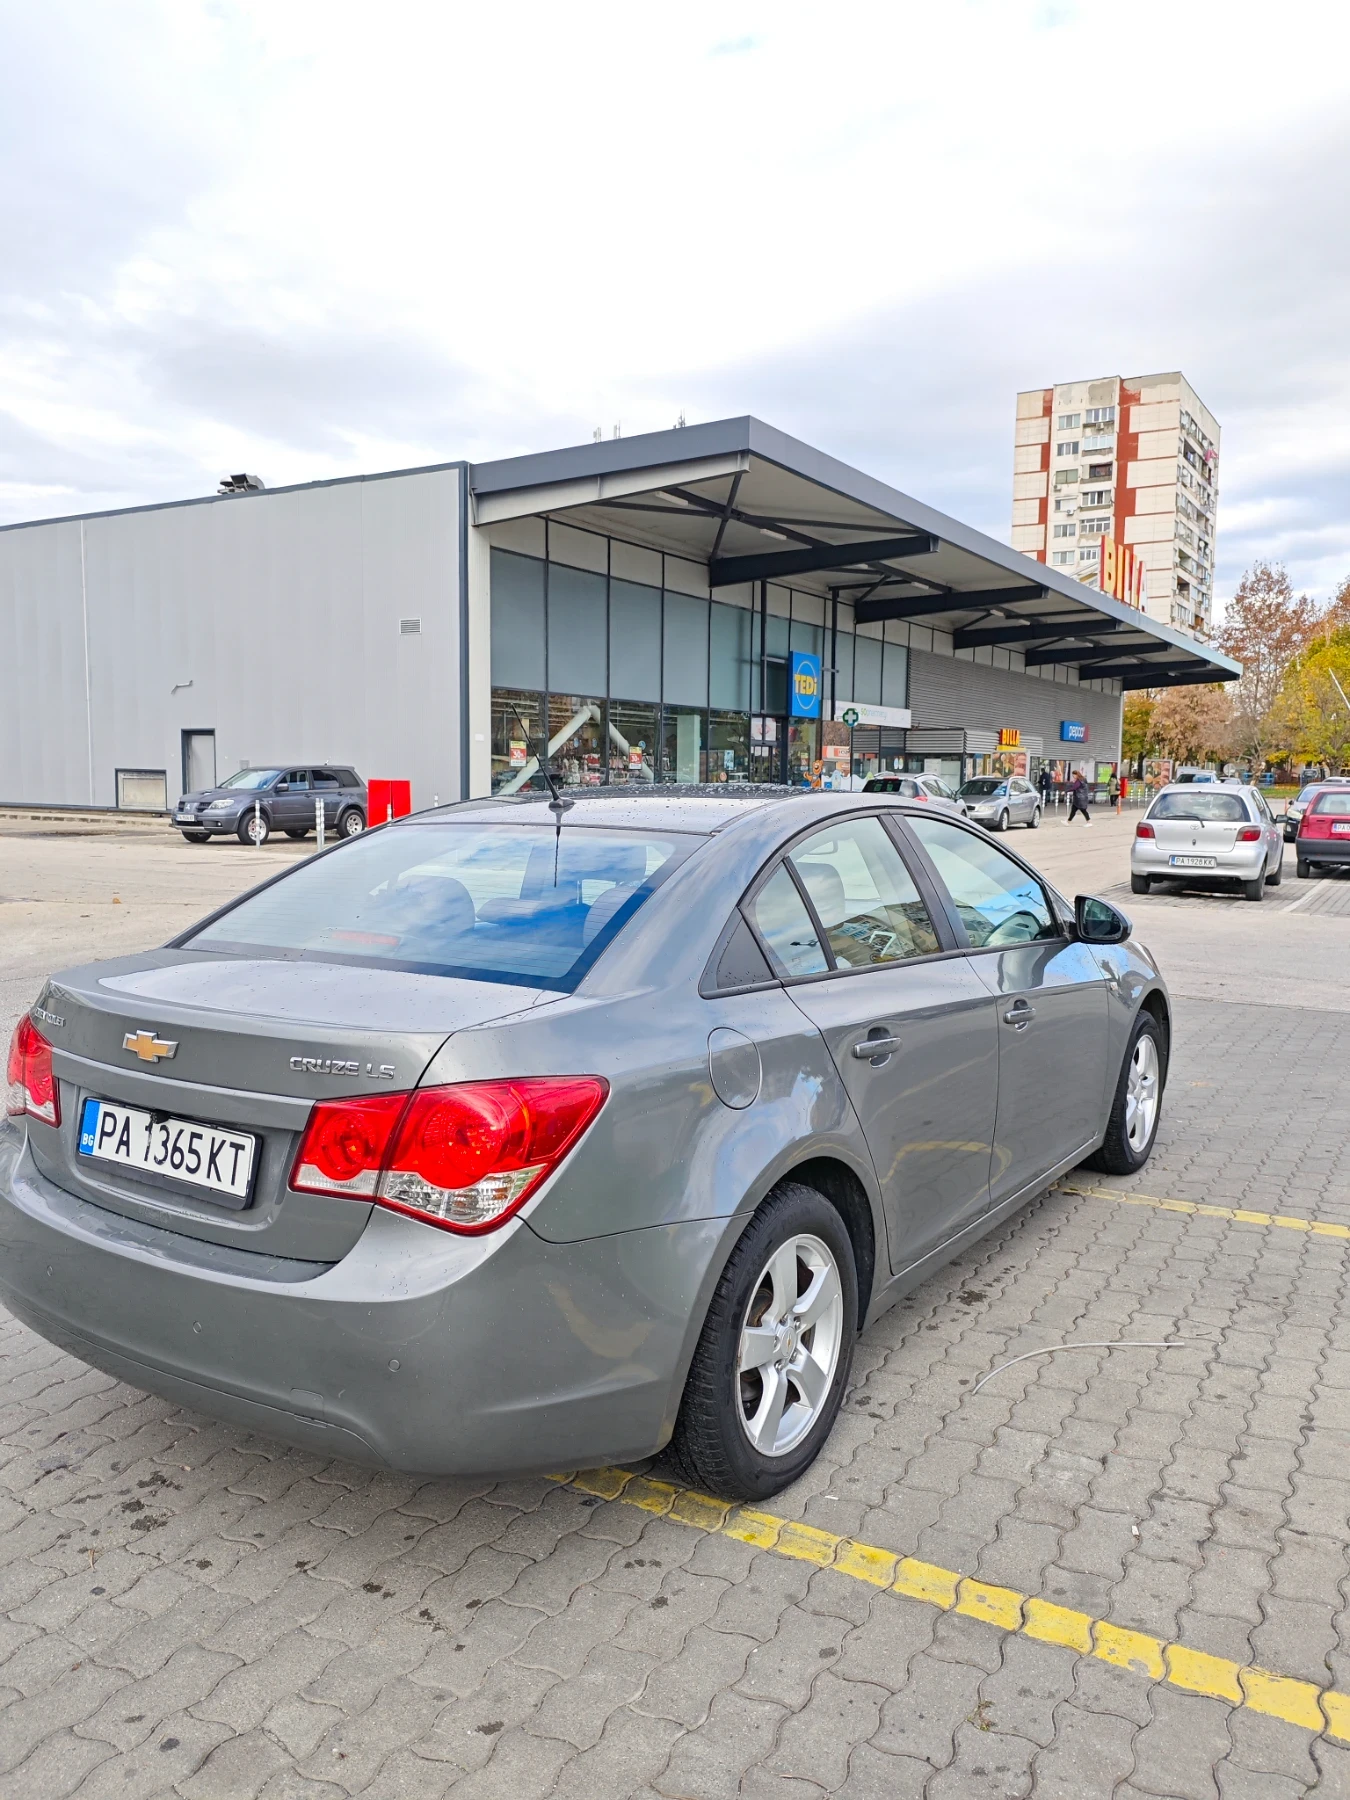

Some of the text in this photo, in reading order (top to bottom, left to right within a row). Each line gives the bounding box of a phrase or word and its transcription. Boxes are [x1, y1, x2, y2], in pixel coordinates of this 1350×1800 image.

[1101, 535, 1148, 613] BILLA
[794, 674, 817, 695] TEDi
[1000, 728, 1020, 746] BILLA
[290, 1056, 395, 1079] CRUZE LS
[82, 1133, 95, 1146] BG
[98, 1111, 245, 1186] PA 1365 KT
